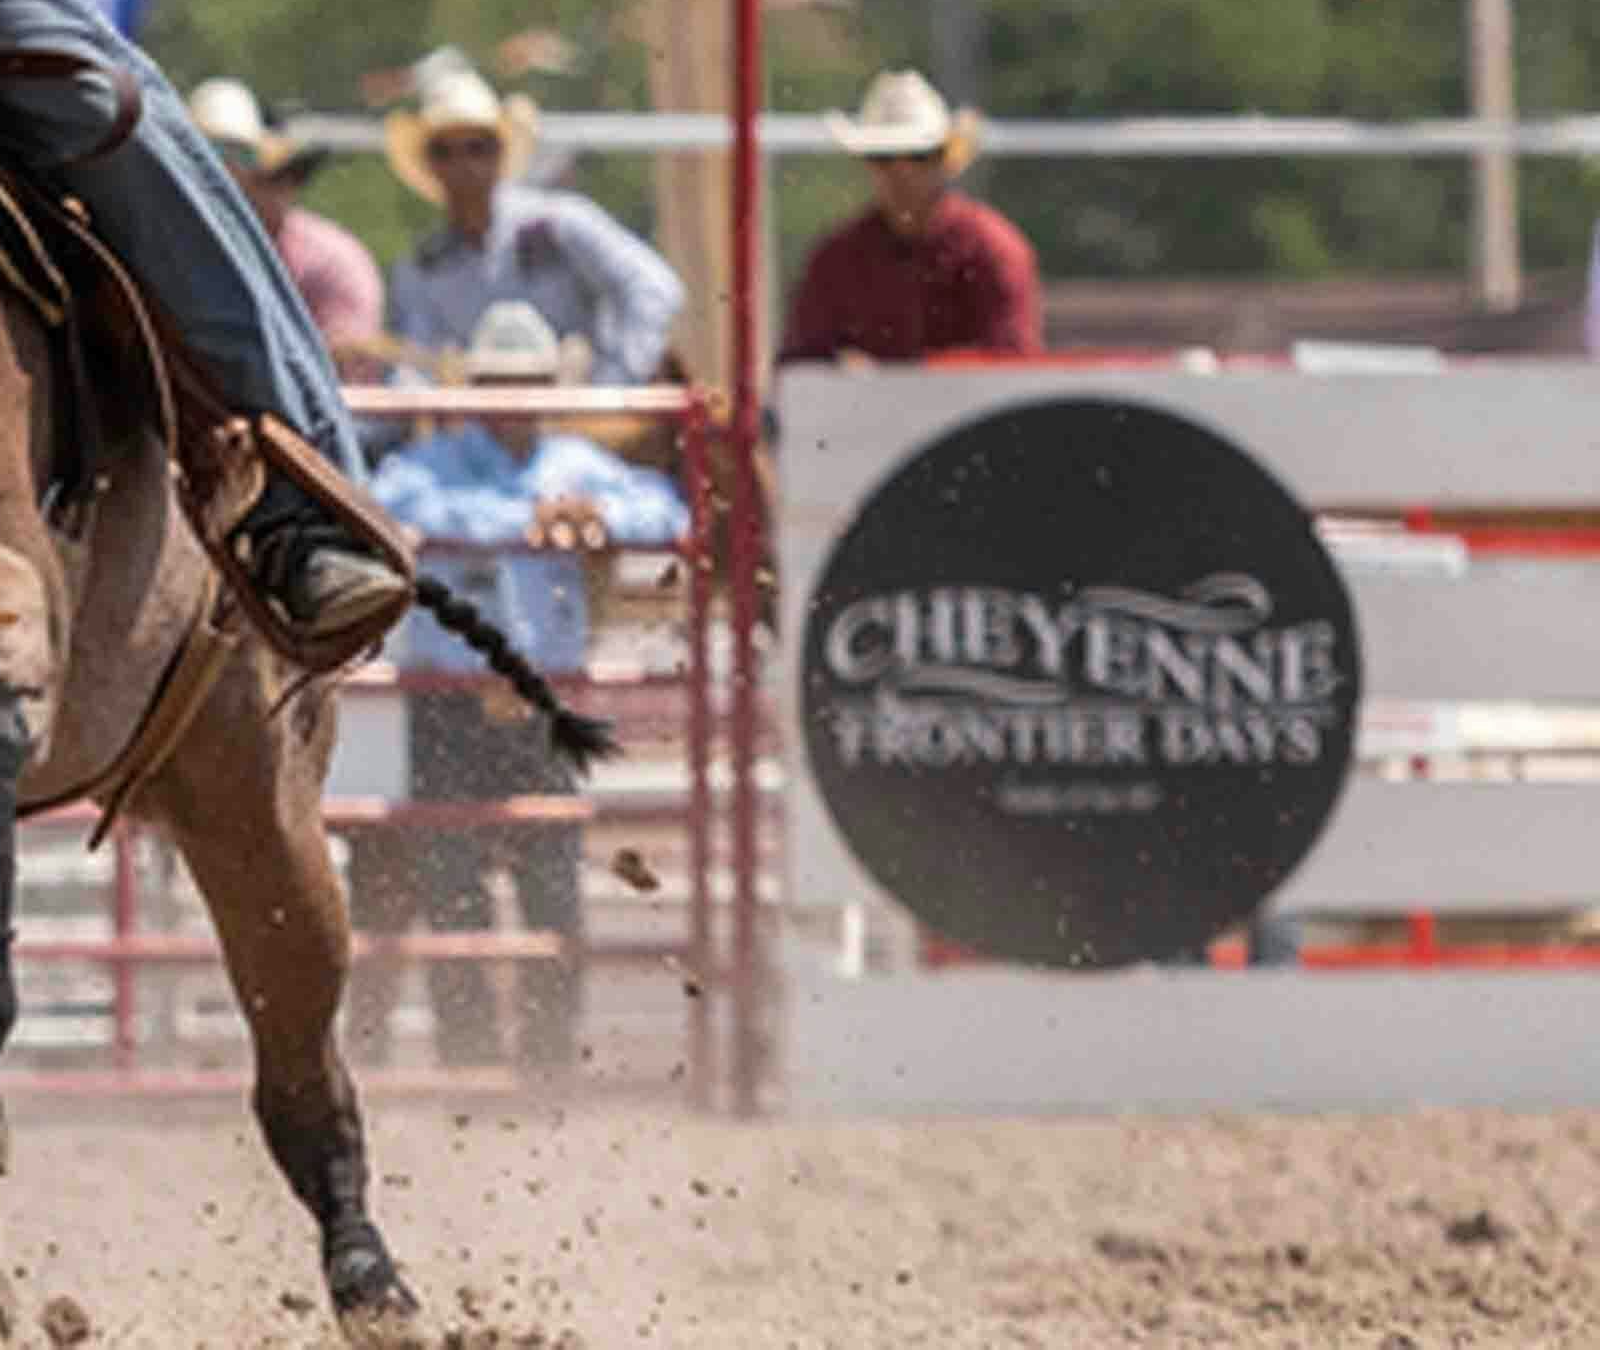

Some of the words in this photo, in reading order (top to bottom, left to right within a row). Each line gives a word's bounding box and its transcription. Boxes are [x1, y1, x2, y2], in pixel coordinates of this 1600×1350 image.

[825, 586, 1335, 714] CHEYENNE
[830, 696, 1146, 764] FRONTIER
[1159, 706, 1323, 764] DAYS
